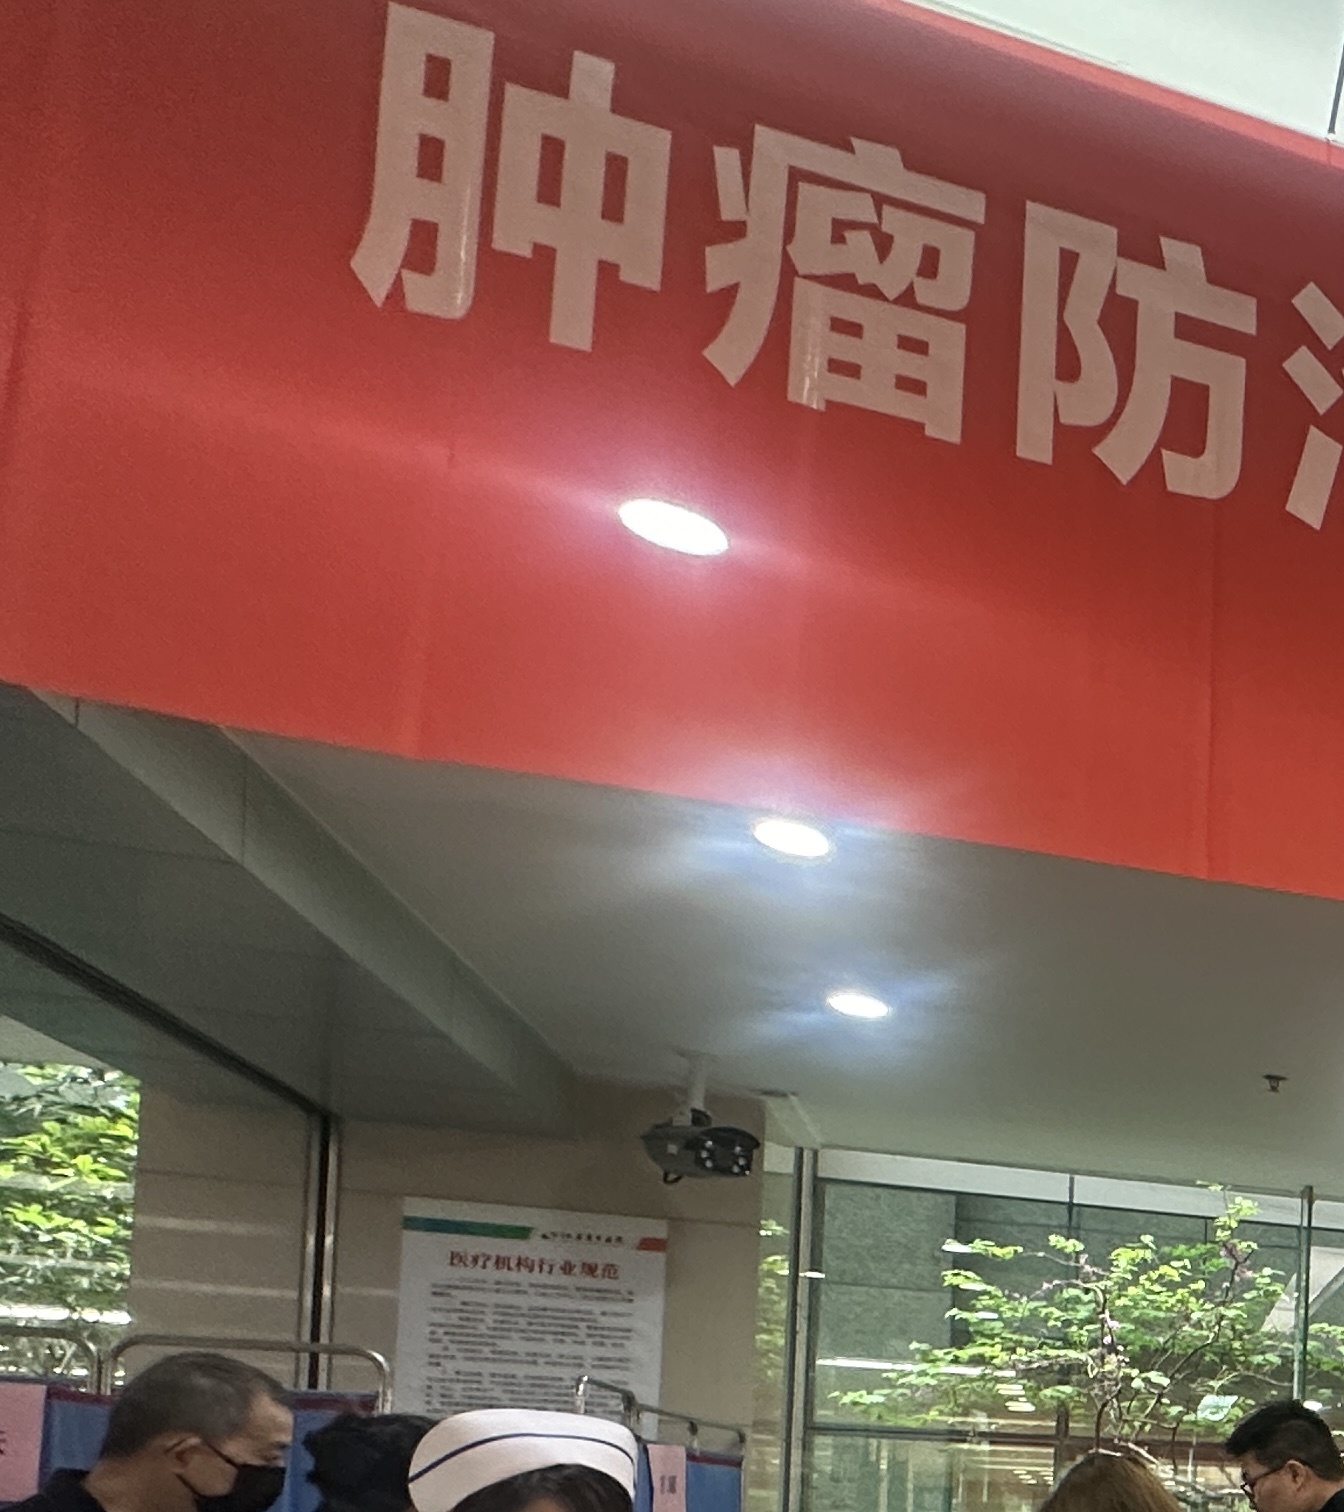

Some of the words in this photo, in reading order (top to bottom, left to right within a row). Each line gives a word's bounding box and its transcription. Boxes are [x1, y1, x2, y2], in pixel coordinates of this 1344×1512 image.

[449, 1250, 621, 1280] 医疗机构行业规范
